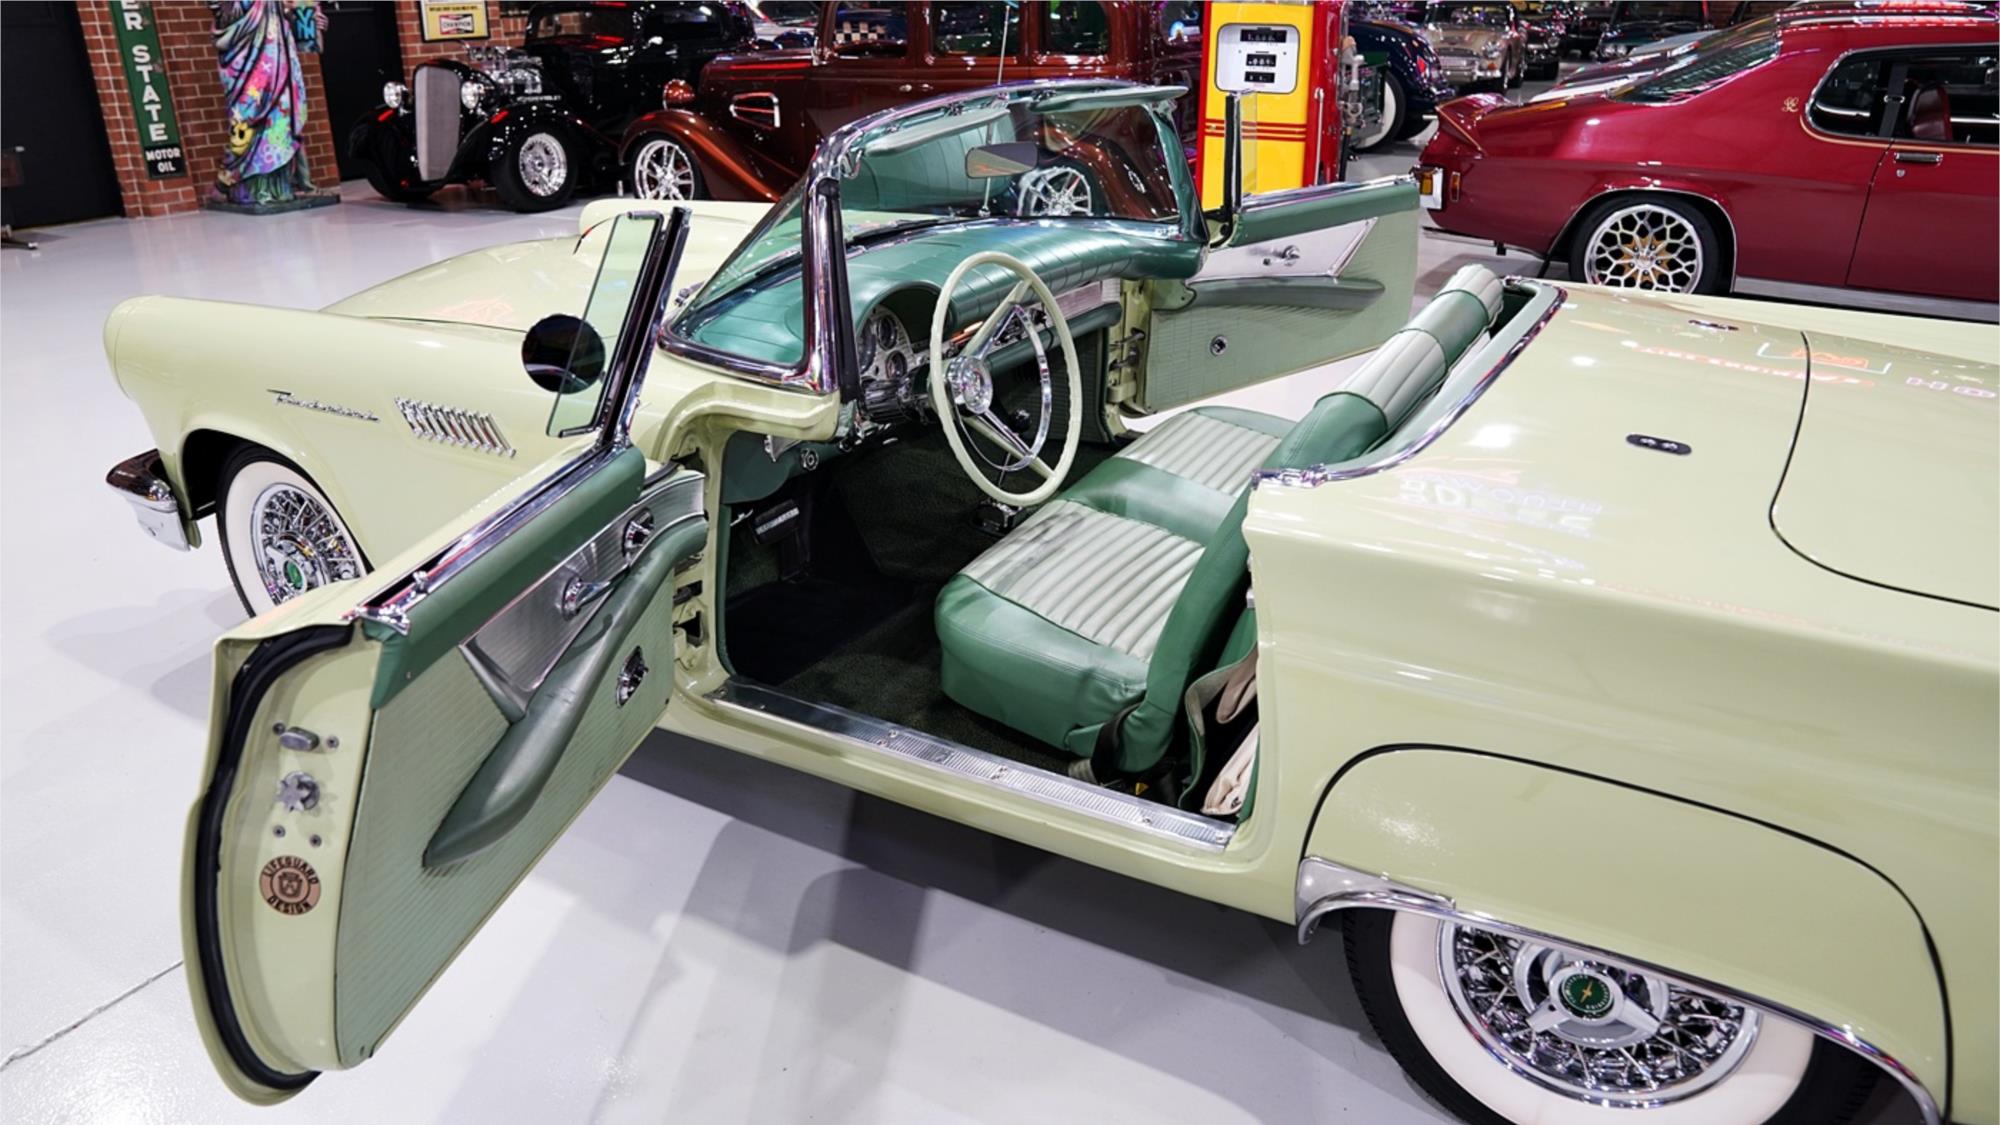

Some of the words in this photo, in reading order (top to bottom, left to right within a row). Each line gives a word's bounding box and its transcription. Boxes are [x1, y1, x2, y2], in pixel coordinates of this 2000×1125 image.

[132, 44, 168, 142] STATE
[146, 148, 181, 161] MOTOR
[157, 161, 176, 173] OIL
[261, 856, 319, 885] LIFEGUARD
[267, 895, 312, 915] DESIGN
